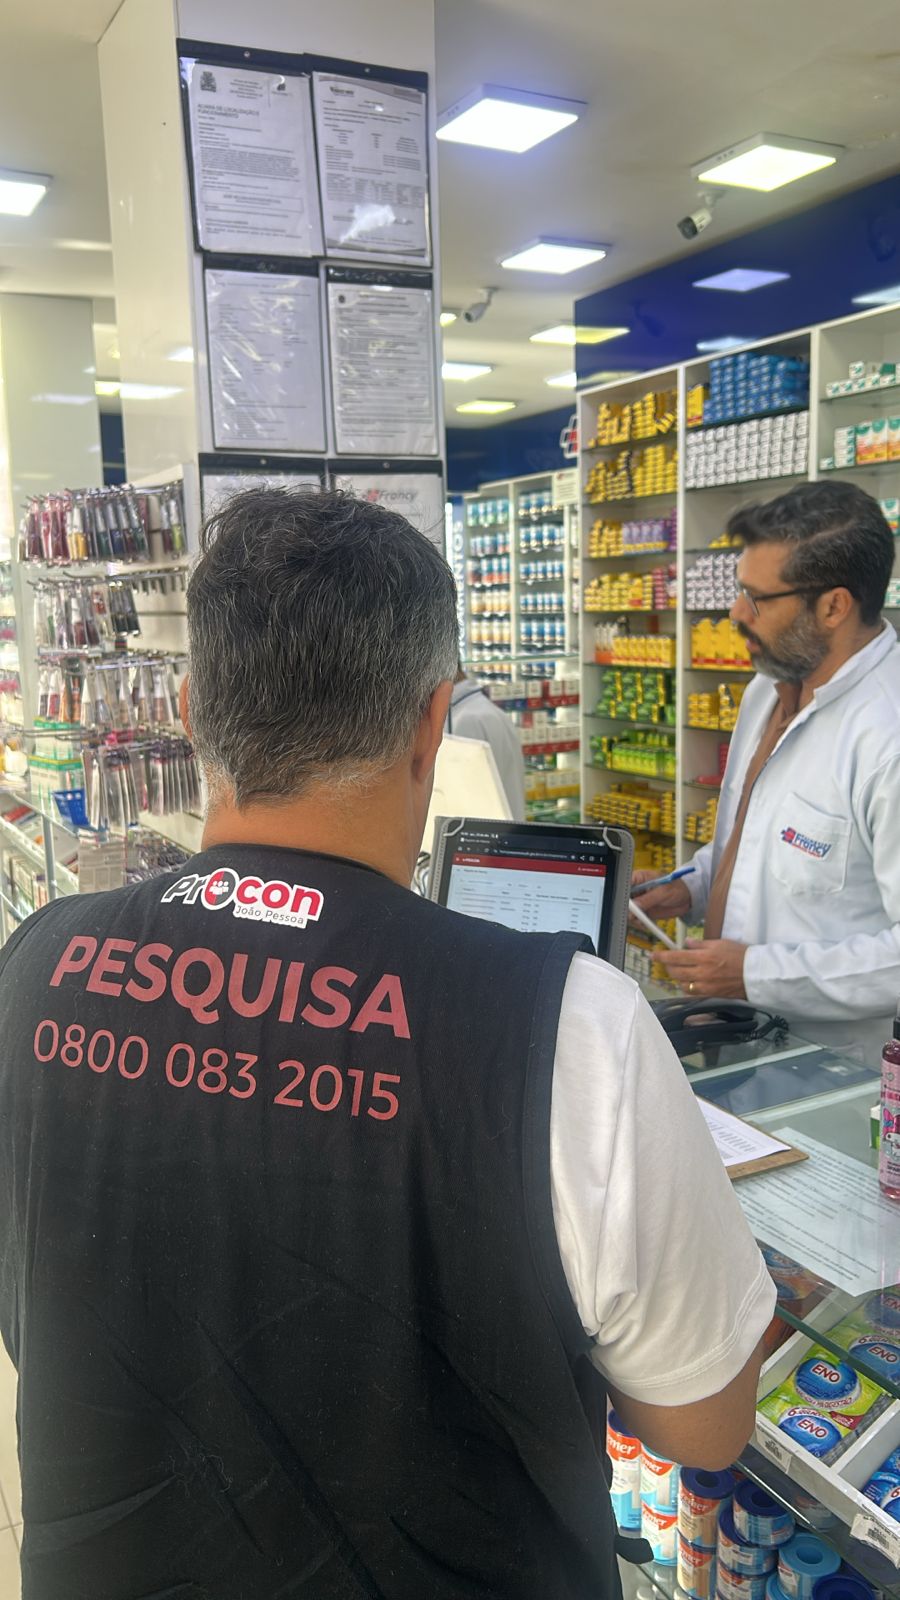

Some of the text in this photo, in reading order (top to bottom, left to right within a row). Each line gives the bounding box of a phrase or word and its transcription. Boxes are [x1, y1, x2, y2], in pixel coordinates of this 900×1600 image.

[380, 489, 418, 502] Francy
[794, 832, 832, 857] Francy
[236, 905, 304, 925] João Pessoa
[49, 935, 411, 1040] PESQUISA
[33, 1019, 401, 1121] 0800 083 2015
[869, 1346, 898, 1363] ENO
[812, 1364, 840, 1383] ENO
[798, 1419, 827, 1438] ENO
